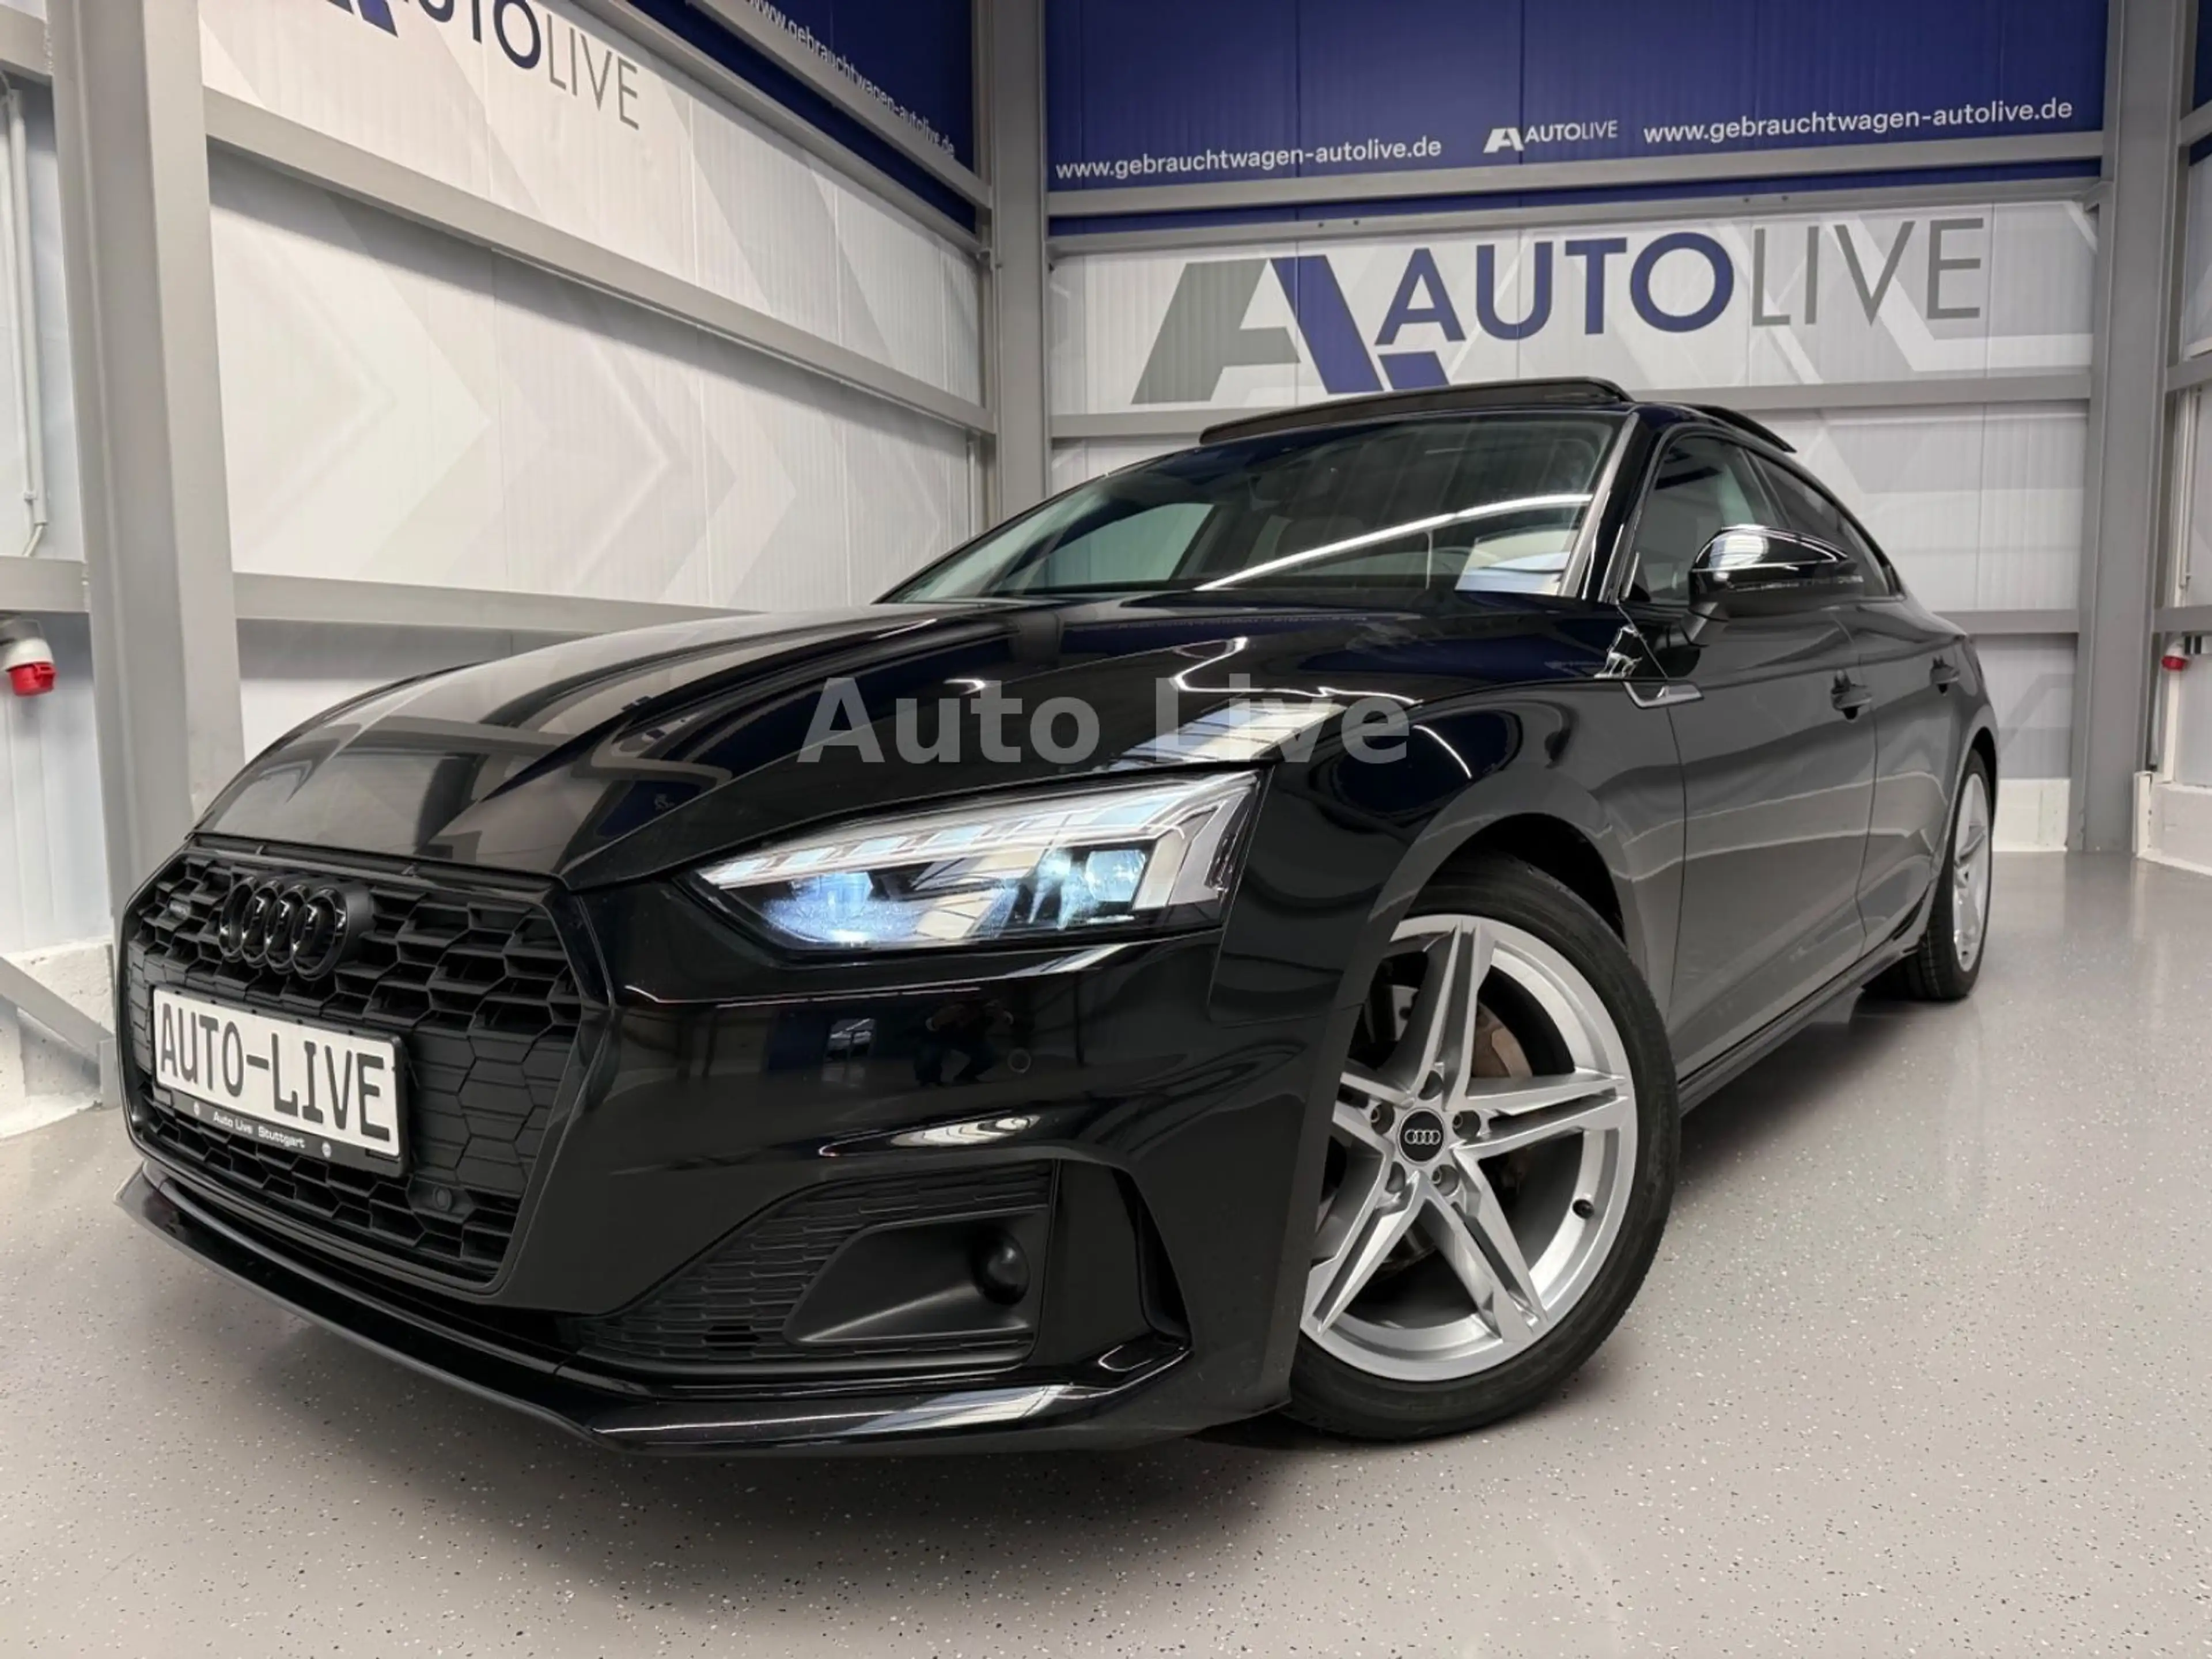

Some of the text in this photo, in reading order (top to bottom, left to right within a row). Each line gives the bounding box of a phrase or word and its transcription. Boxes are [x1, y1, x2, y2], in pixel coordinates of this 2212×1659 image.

[403, 0, 639, 130] OLIVE
[1525, 120, 1619, 143] AUTOLIVE
[1643, 97, 2073, 145] www.gebrauchtwagen-autolive.de
[1056, 135, 1442, 179] www.gebrauchtwagen-autolive.de
[1374, 217, 1984, 346] AUTOLIVE
[161, 1003, 390, 1142] AUTO-LIVE
[213, 1111, 306, 1149] Auto Live Stuttgart
